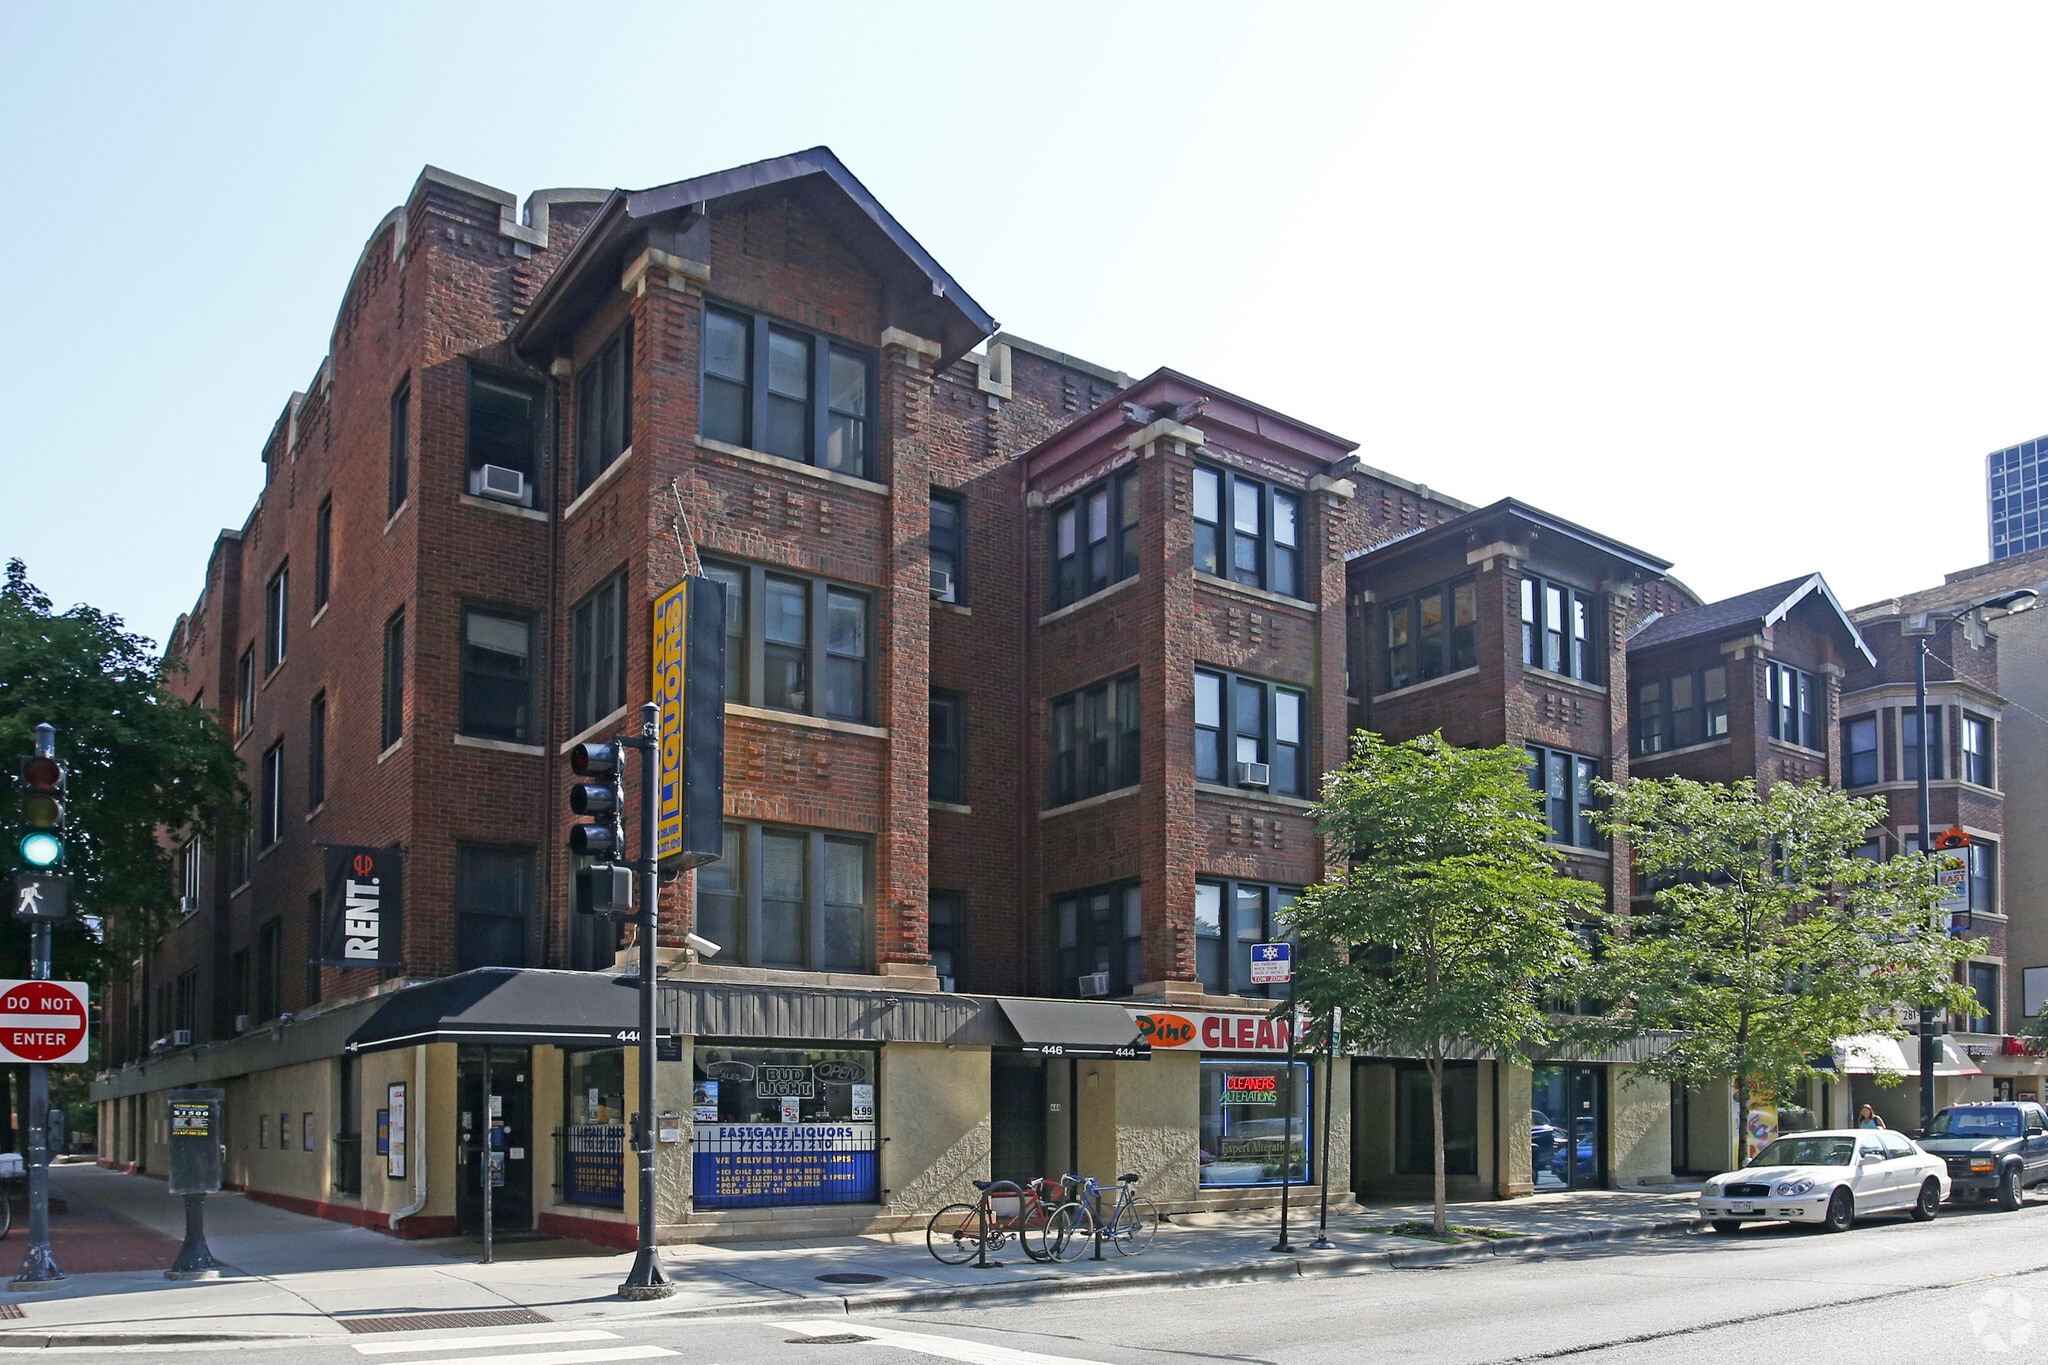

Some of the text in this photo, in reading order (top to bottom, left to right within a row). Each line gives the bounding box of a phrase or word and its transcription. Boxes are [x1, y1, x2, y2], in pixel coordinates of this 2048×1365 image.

[661, 597, 681, 817] LIQUORS
[1940, 873, 1965, 884] EAST
[344, 877, 380, 960] RENT.
[7, 996, 73, 1011] DO NOT
[13, 1032, 66, 1046] ENTER
[1041, 1045, 1063, 1055] 446
[1115, 1048, 1135, 1057] 444
[766, 1068, 804, 1082] BUD
[820, 1064, 860, 1081] OPEN
[759, 1082, 812, 1096] LIGHT
[1227, 1077, 1276, 1091] CLEANERS
[1220, 1090, 1277, 1103] ALTERATIONS
[720, 1127, 853, 1138] EASTGATE LIQUORS
[1222, 1142, 1250, 1155] Expert
[736, 1156, 773, 1164] DELIVER
